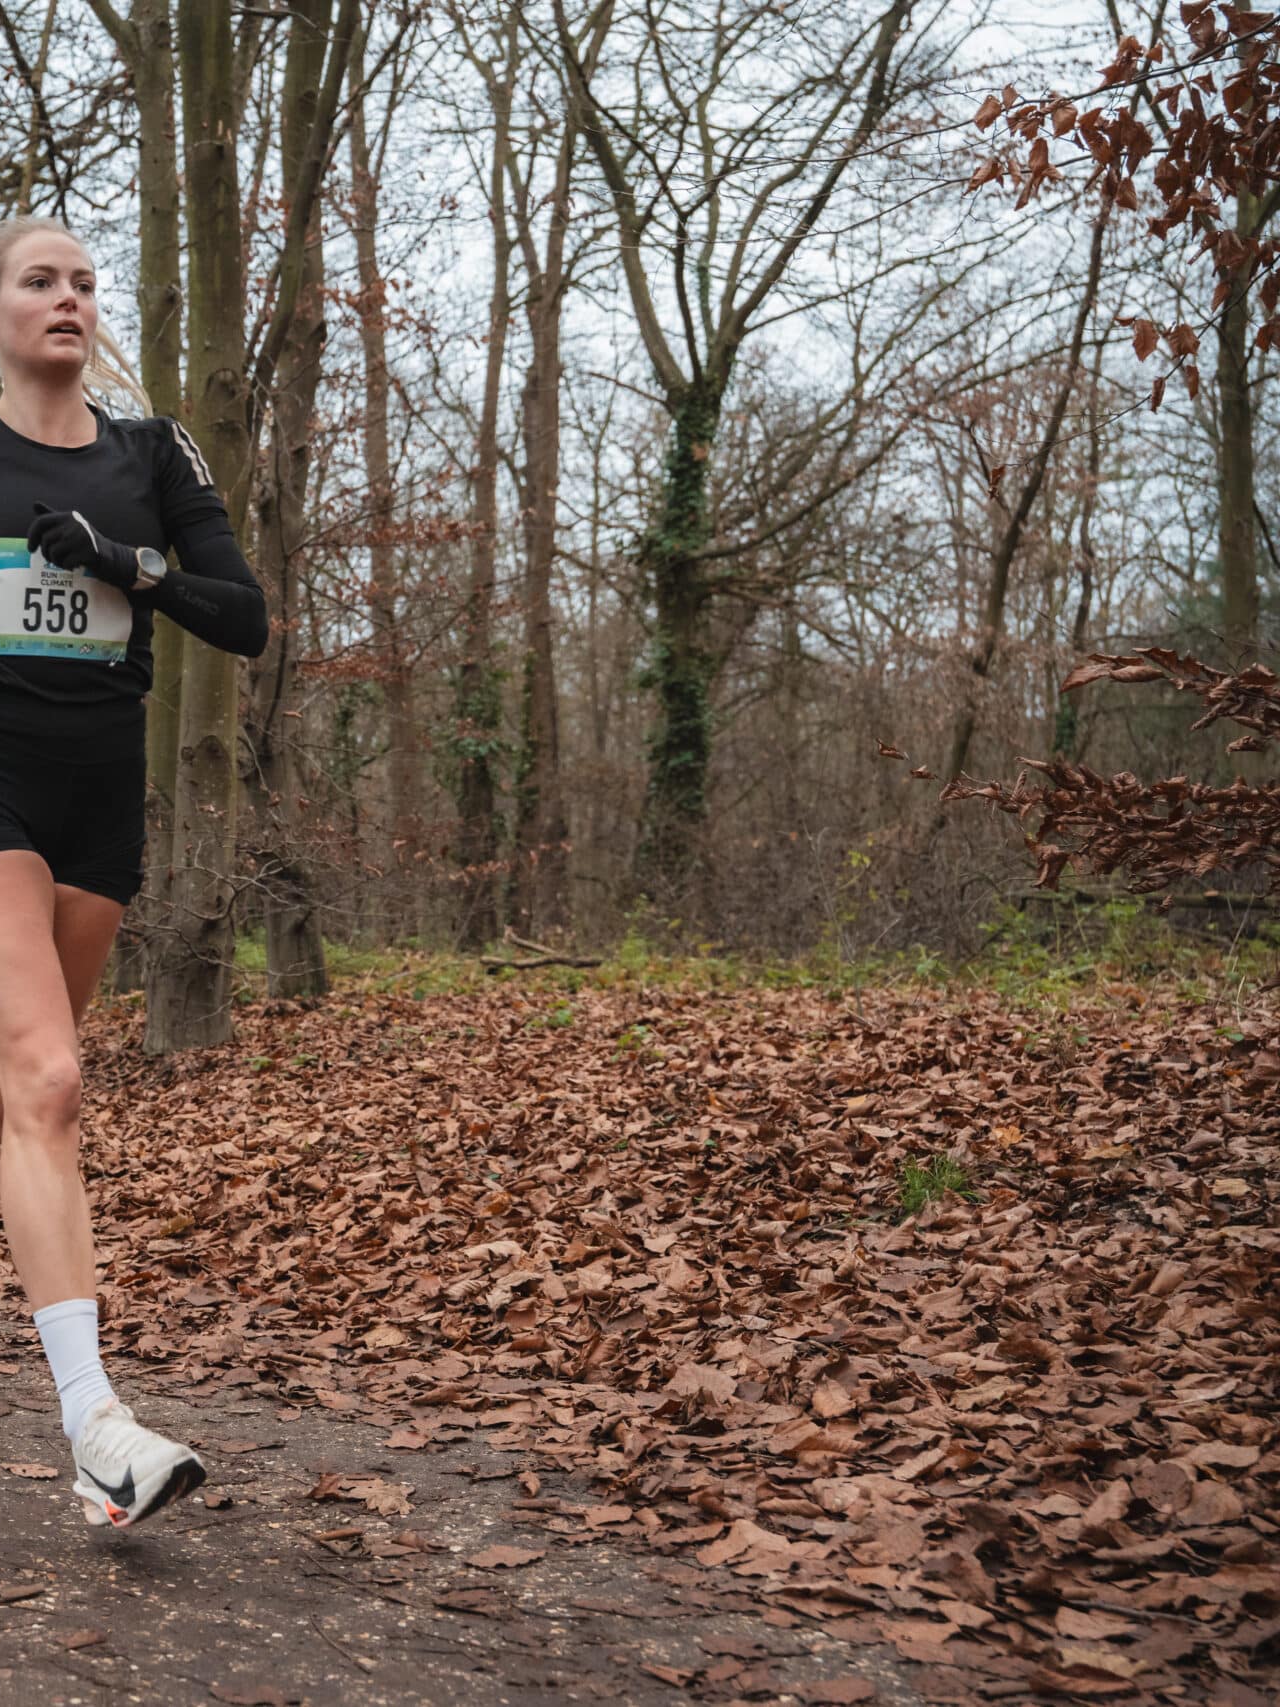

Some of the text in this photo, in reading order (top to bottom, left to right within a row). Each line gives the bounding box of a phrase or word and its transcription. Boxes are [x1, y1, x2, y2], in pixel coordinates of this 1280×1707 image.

[41, 572, 58, 580] RUN
[40, 579, 73, 588] CLIMATE
[23, 587, 88, 635] 558
